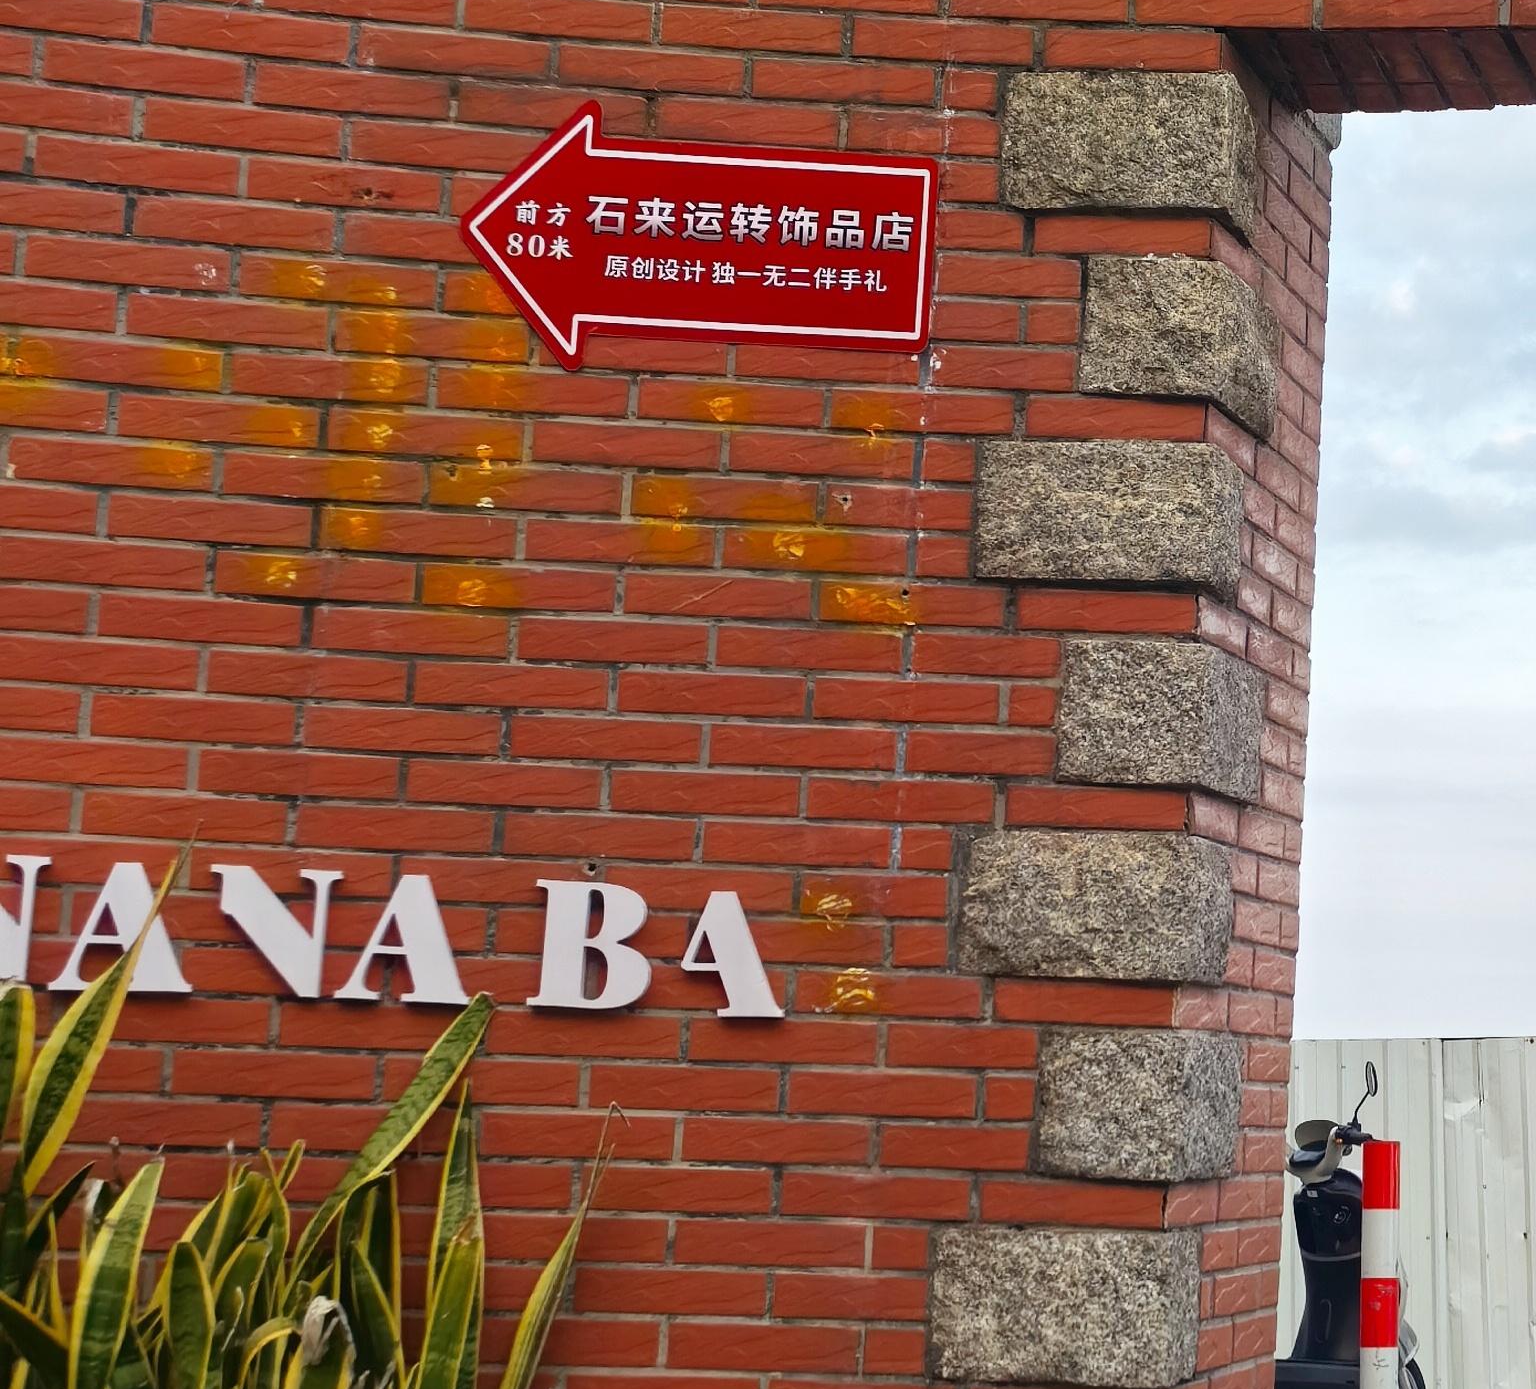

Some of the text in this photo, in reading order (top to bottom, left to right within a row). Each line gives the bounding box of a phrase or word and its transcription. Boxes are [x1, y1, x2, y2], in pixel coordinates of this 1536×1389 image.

[514, 200, 572, 225] 前方
[585, 194, 915, 252] 石来运转饰品店
[506, 232, 573, 260] 80米
[604, 255, 888, 293] 原创设计 独一无二伴手礼
[526, 878, 786, 1019] BA
